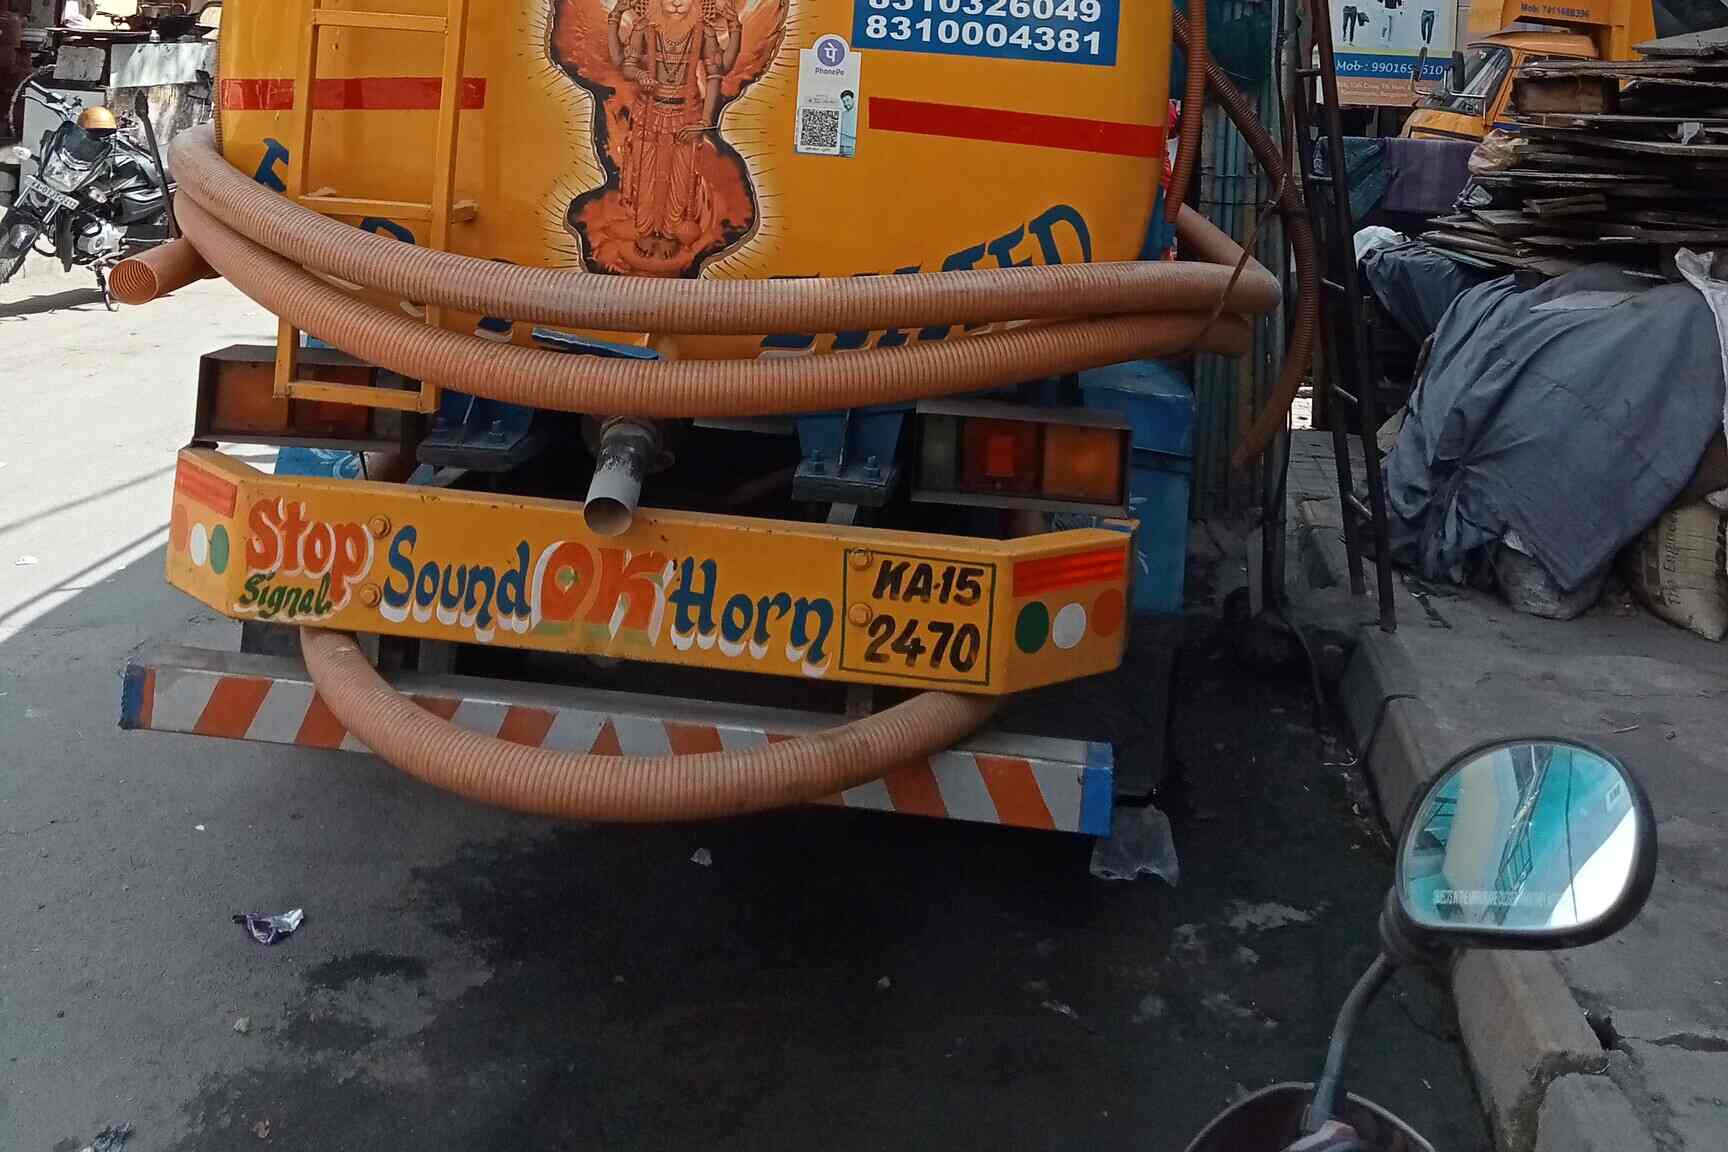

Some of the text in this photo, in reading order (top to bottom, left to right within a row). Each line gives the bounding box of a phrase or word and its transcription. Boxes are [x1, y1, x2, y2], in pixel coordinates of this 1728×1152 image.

[865, 15, 1100, 55] 8310004381
[815, 67, 845, 76] PhonePe
[239, 571, 333, 618] Signal
[245, 497, 835, 666] Stop Sound OK Horn
[864, 612, 981, 673] 2470
